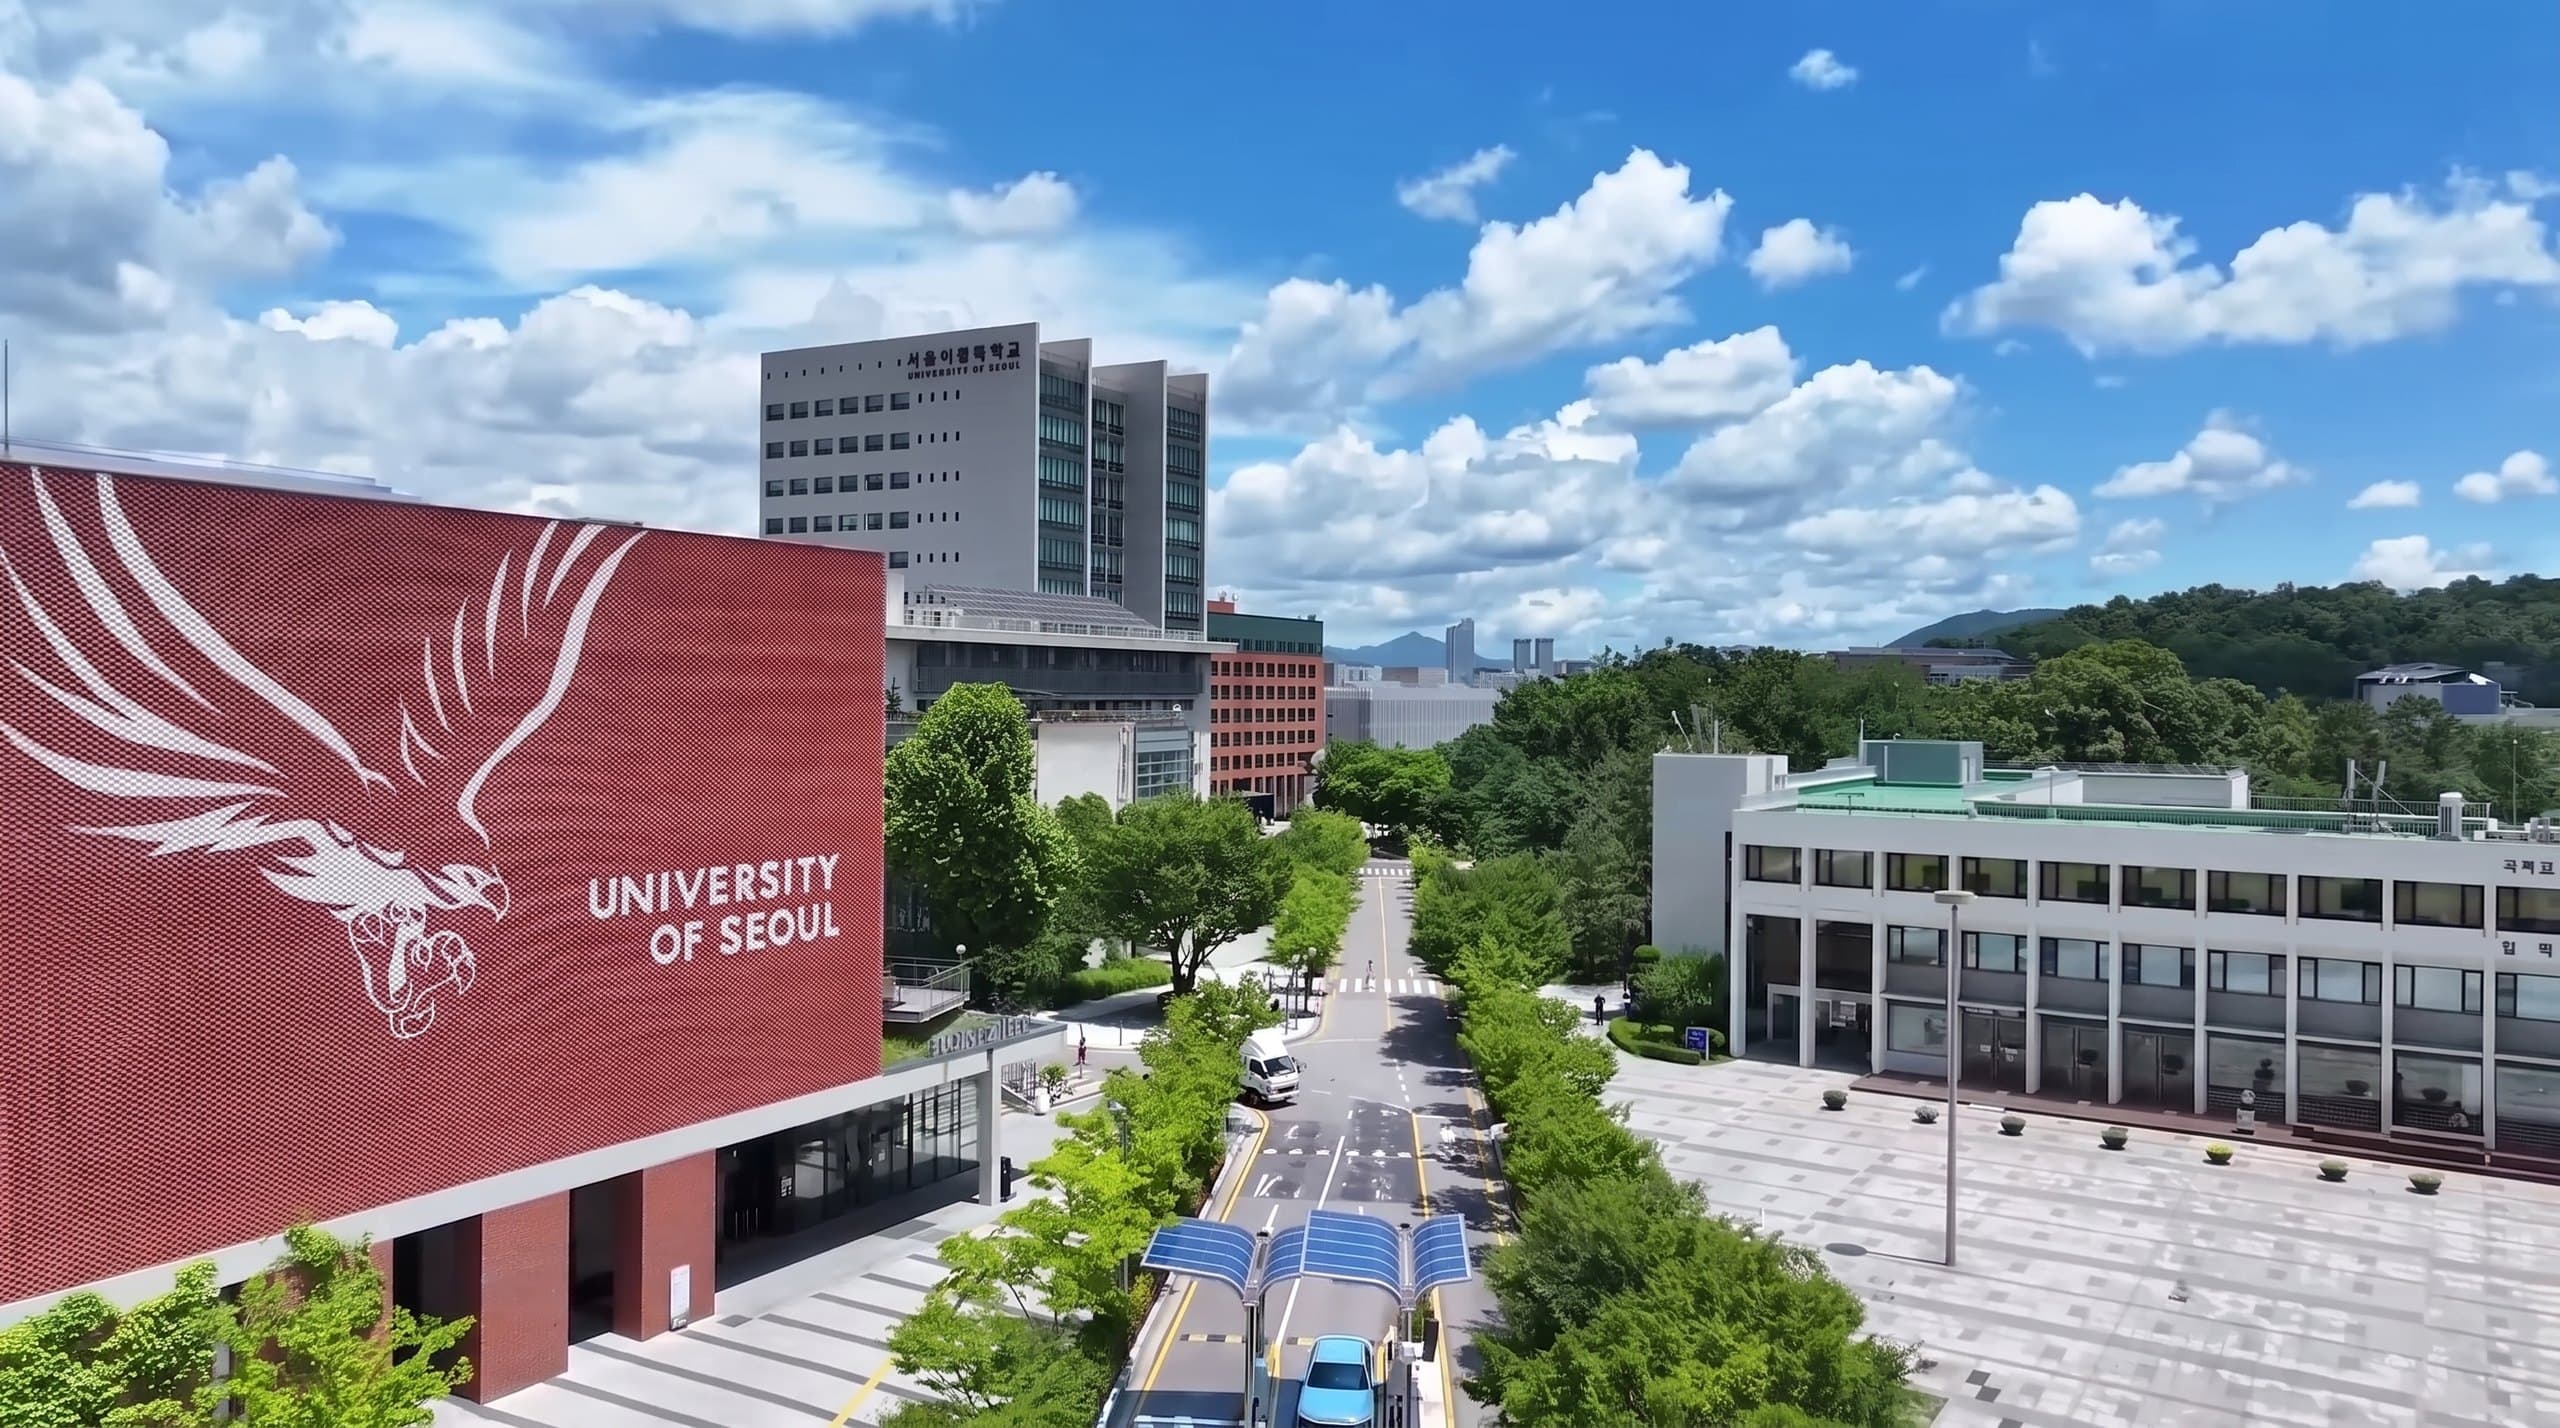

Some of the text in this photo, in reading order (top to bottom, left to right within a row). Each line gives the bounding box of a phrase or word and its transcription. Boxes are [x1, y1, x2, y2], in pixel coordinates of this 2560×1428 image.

[973, 365, 985, 374] OF
[989, 361, 1021, 372] SEOUL
[588, 853, 840, 920] UNIVERSITY
[649, 902, 840, 966] OF SEOUL
